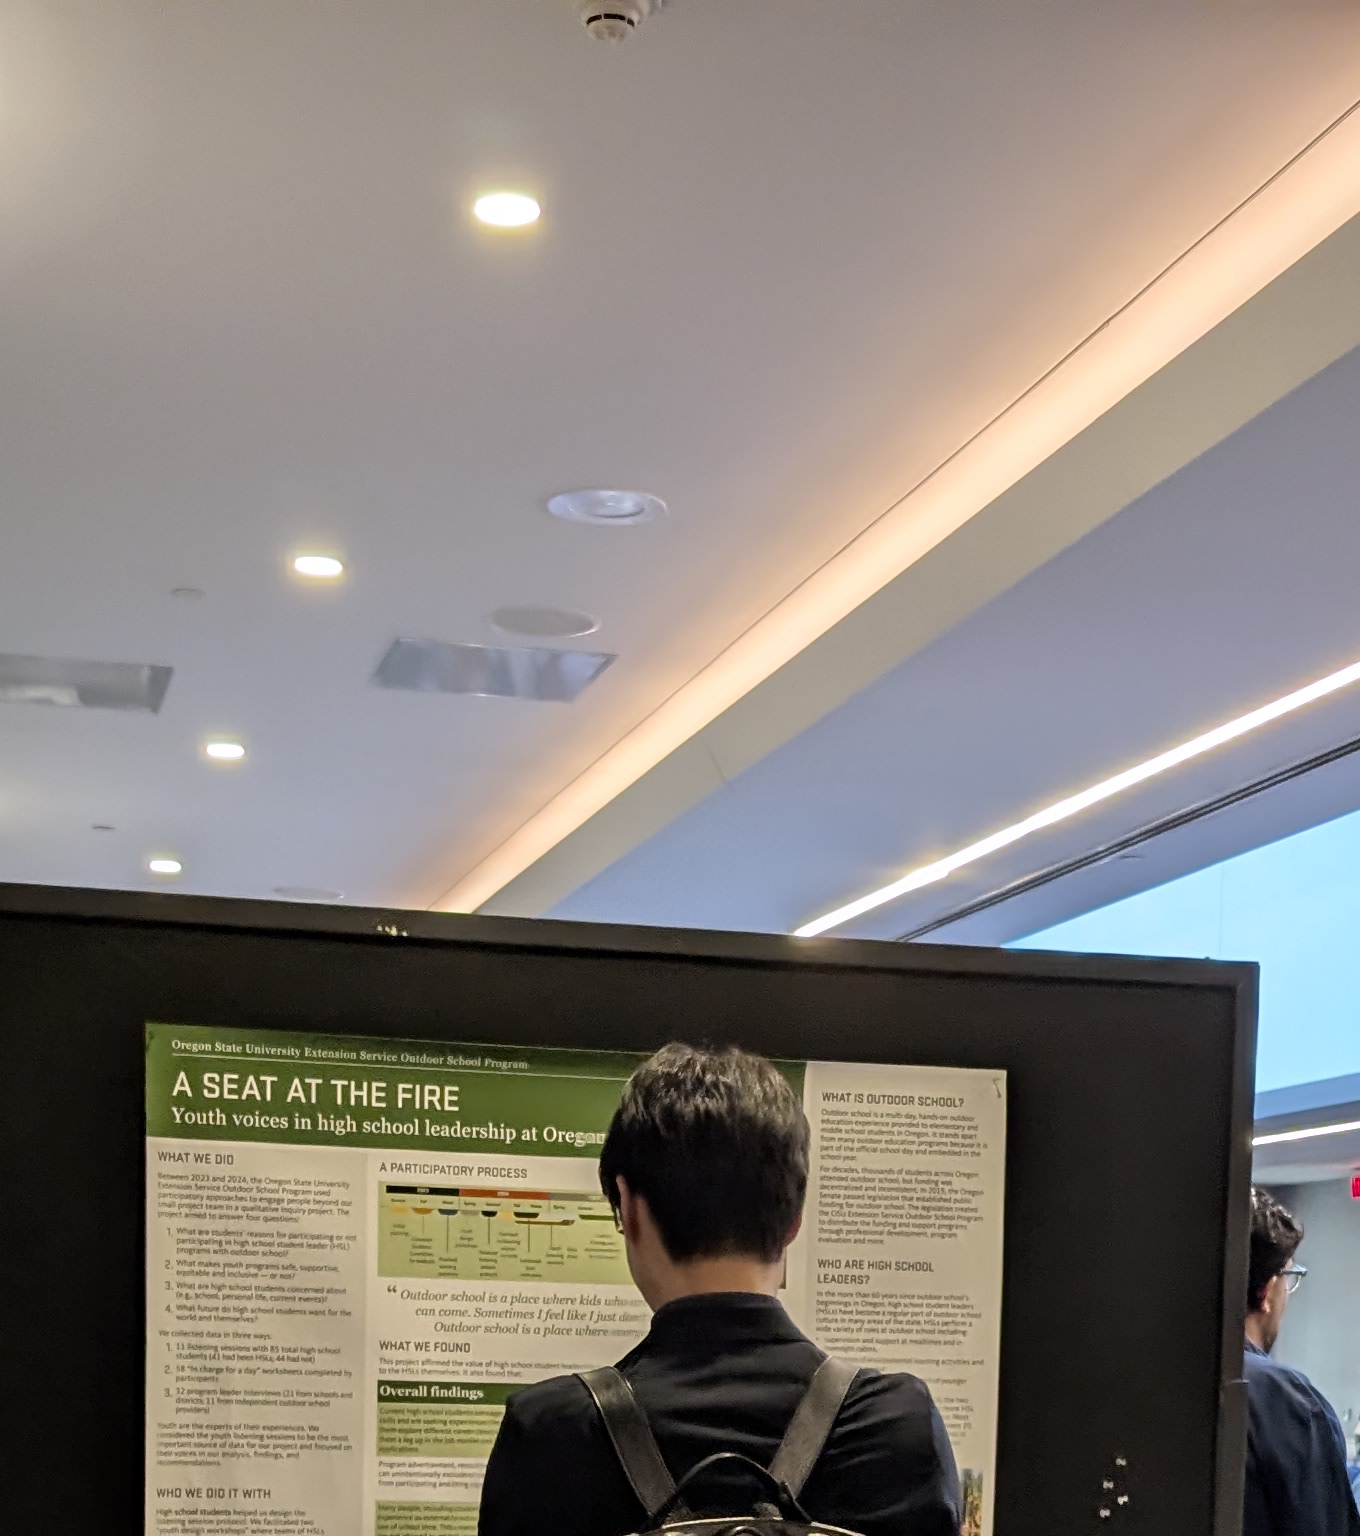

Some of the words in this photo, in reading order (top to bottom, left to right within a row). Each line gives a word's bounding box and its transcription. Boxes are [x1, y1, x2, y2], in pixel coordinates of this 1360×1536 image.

[172, 1040, 212, 1052] Oregon
[215, 1043, 241, 1053] State
[246, 1044, 300, 1058] University
[305, 1047, 356, 1059] Extension
[360, 1051, 398, 1062] Service
[401, 1053, 444, 1065] Outdoor
[447, 1056, 481, 1067] School
[484, 1058, 528, 1070] Program
[172, 1071, 192, 1097] A
[203, 1072, 278, 1101] SEAT
[287, 1078, 323, 1104] AT
[330, 1079, 387, 1108] THE
[397, 1083, 459, 1111] FIRE
[822, 1092, 851, 1103] WHAT
[855, 1094, 863, 1103] IS
[867, 1094, 915, 1105] OUTDOOR
[917, 1096, 964, 1108] SCHOOL?
[171, 1107, 226, 1125] Youth
[232, 1111, 289, 1128] voices
[294, 1113, 312, 1130] in
[317, 1114, 357, 1135] high
[362, 1116, 419, 1136] school
[425, 1119, 516, 1144] leadership
[522, 1128, 538, 1141] at
[158, 1151, 190, 1163] WHAT
[194, 1153, 211, 1164] WE
[215, 1154, 234, 1165] DID
[380, 1162, 387, 1172] A
[391, 1163, 474, 1176] PARTICIPATORY
[478, 1167, 527, 1178] PROCESS
[158, 1182, 192, 1190] Extension
[195, 1184, 220, 1192] Service
[223, 1185, 253, 1193] Outdoor
[256, 1186, 279, 1194] School
[282, 1187, 312, 1196] Program
[265, 1177, 291, 1186] Oregon
[314, 1180, 350, 1189] University
[176, 1259, 195, 1268] What
[246, 1263, 279, 1271] programs
[818, 1259, 841, 1269] WHO
[844, 1260, 864, 1270] ARE
[868, 1261, 891, 1271] HIGH
[895, 1261, 934, 1272] SCHOOL
[817, 1274, 870, 1285] LEADERS?
[400, 1289, 448, 1301] Outdoor
[451, 1291, 486, 1303] school
[489, 1292, 498, 1303] is
[500, 1295, 508, 1303] a
[510, 1293, 540, 1305] place
[543, 1294, 577, 1305] where
[580, 1294, 602, 1306] kids
[439, 1309, 471, 1317] come.
[474, 1308, 534, 1319] Sometimes
[537, 1310, 543, 1319] I
[544, 1309, 565, 1321] feel
[567, 1311, 586, 1321] like
[589, 1311, 595, 1321] I
[596, 1311, 616, 1322] just
[233, 1331, 251, 1339] three
[434, 1322, 482, 1333] Outdoor
[484, 1323, 519, 1334] school
[522, 1324, 530, 1334] is
[533, 1327, 540, 1335] a
[543, 1325, 573, 1337] place
[576, 1326, 608, 1337] where
[379, 1341, 412, 1351] WHAT
[414, 1342, 431, 1352] WE
[434, 1343, 471, 1353] FOUND
[395, 1359, 419, 1368] project
[452, 1360, 463, 1368] the
[494, 1361, 509, 1370] high
[380, 1385, 427, 1397] Overall
[431, 1386, 484, 1400] findings
[156, 1488, 182, 1498] WHO
[185, 1488, 202, 1498] WE
[206, 1488, 225, 1498] DID
[229, 1489, 238, 1498] IT
[242, 1489, 271, 1499] WITH
